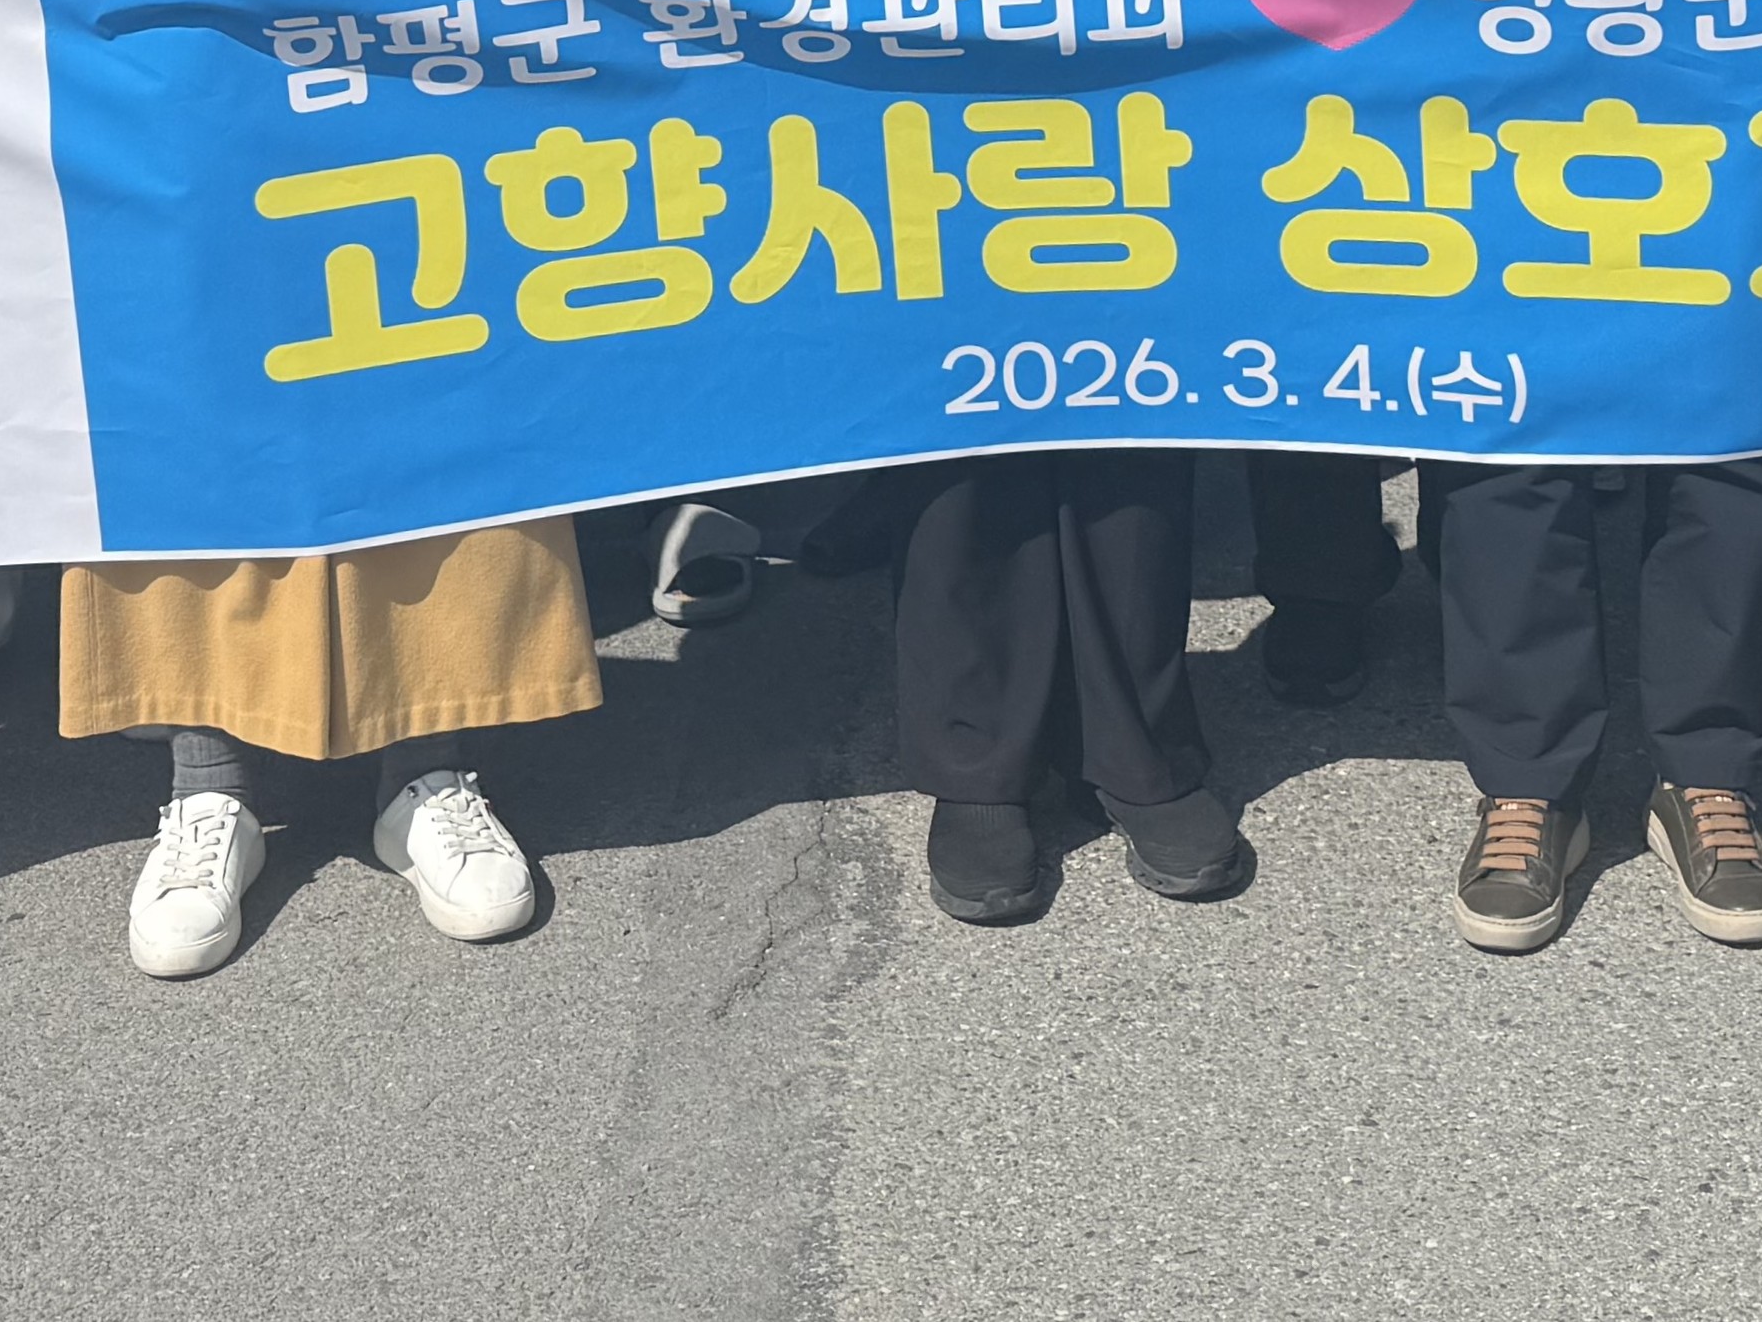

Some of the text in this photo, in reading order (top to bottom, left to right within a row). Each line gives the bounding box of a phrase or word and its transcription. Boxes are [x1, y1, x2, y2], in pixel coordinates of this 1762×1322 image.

[254, 93, 1192, 383] 고향사랑
[941, 338, 1528, 424] 2026. 3. 4.(수)
